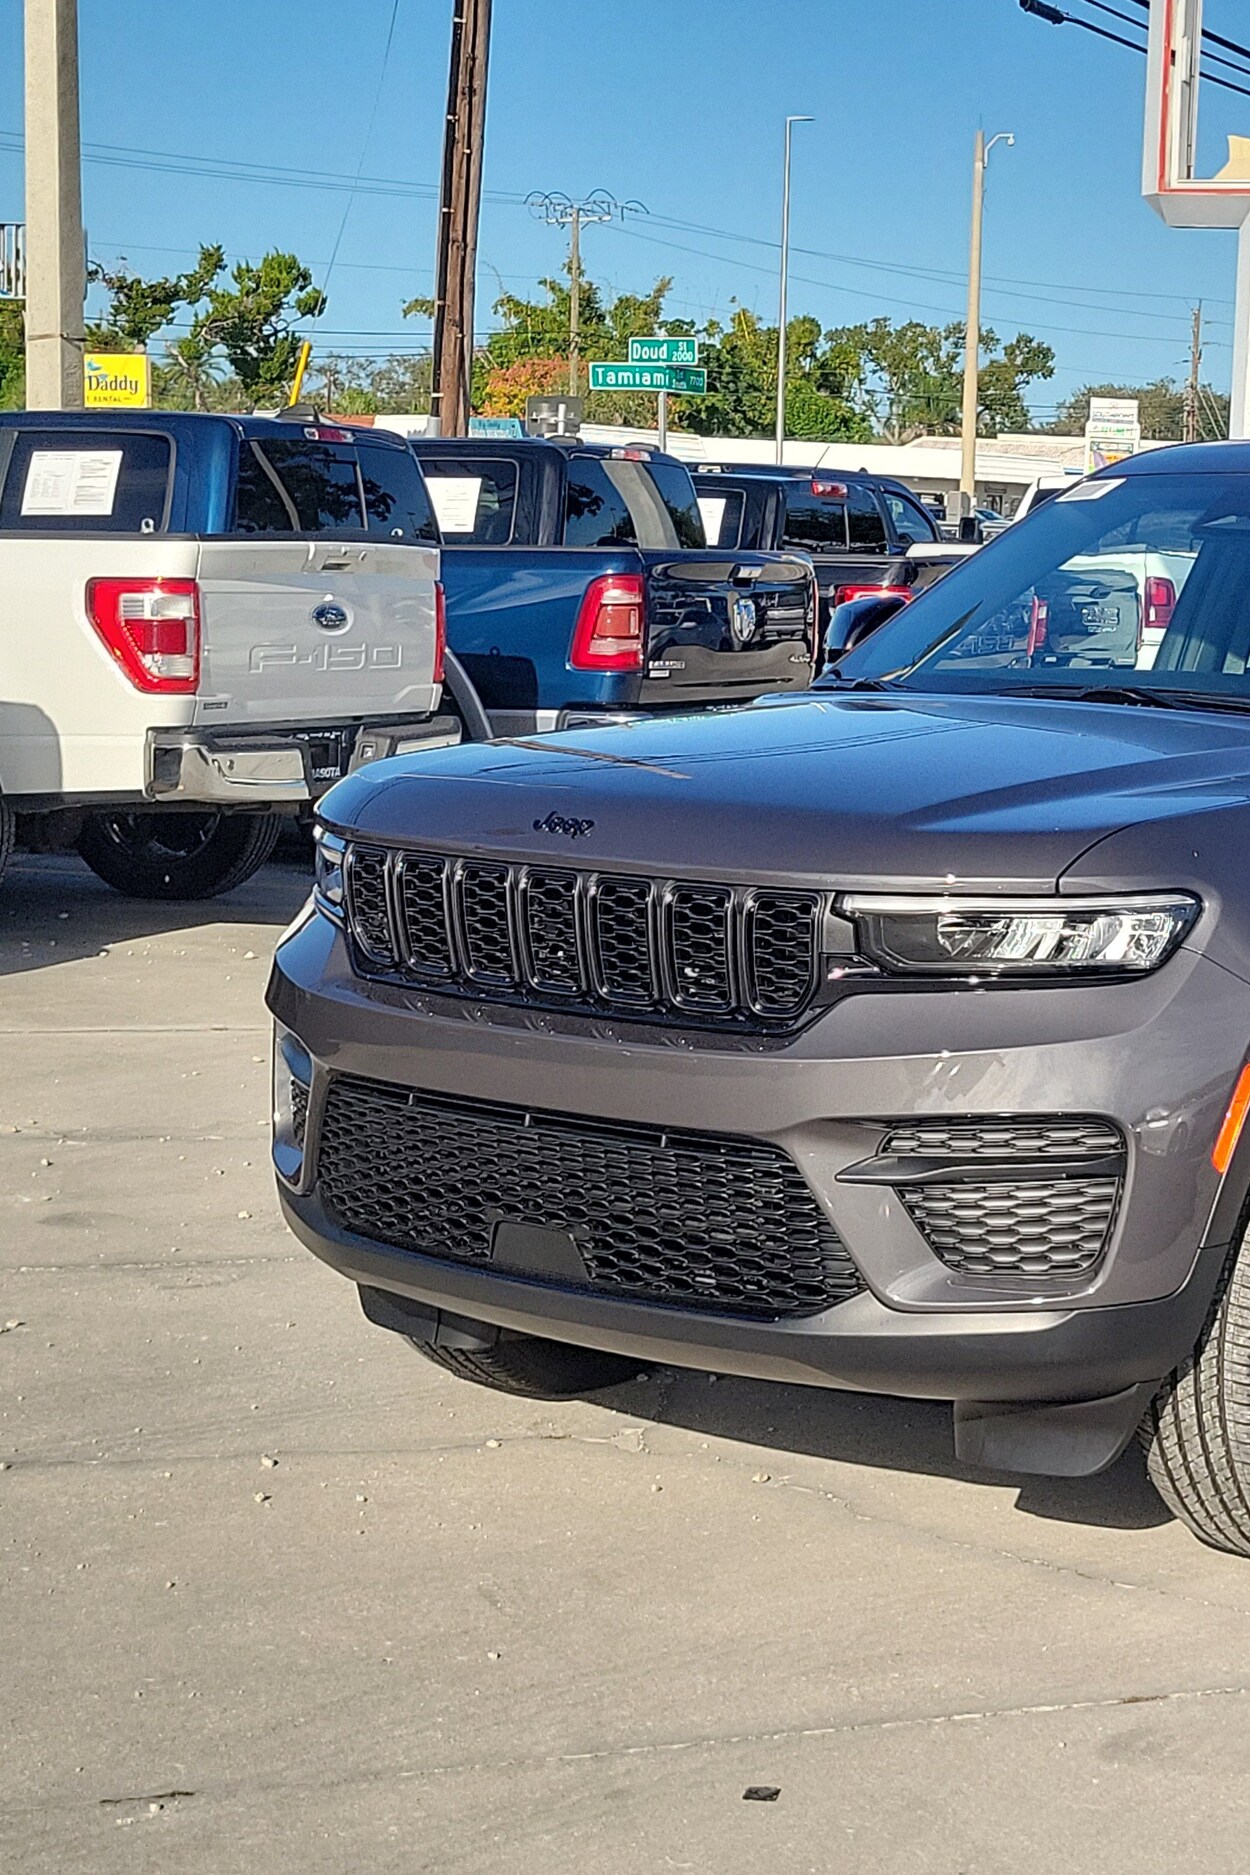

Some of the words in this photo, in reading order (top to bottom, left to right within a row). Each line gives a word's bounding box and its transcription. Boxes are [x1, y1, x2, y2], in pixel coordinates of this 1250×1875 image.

[632, 343, 668, 360] Doud
[672, 351, 693, 362] 2000
[88, 375, 139, 395] Daddy
[595, 367, 670, 387] Tamiami
[249, 642, 402, 674] F-150
[532, 810, 596, 840] Jeep
